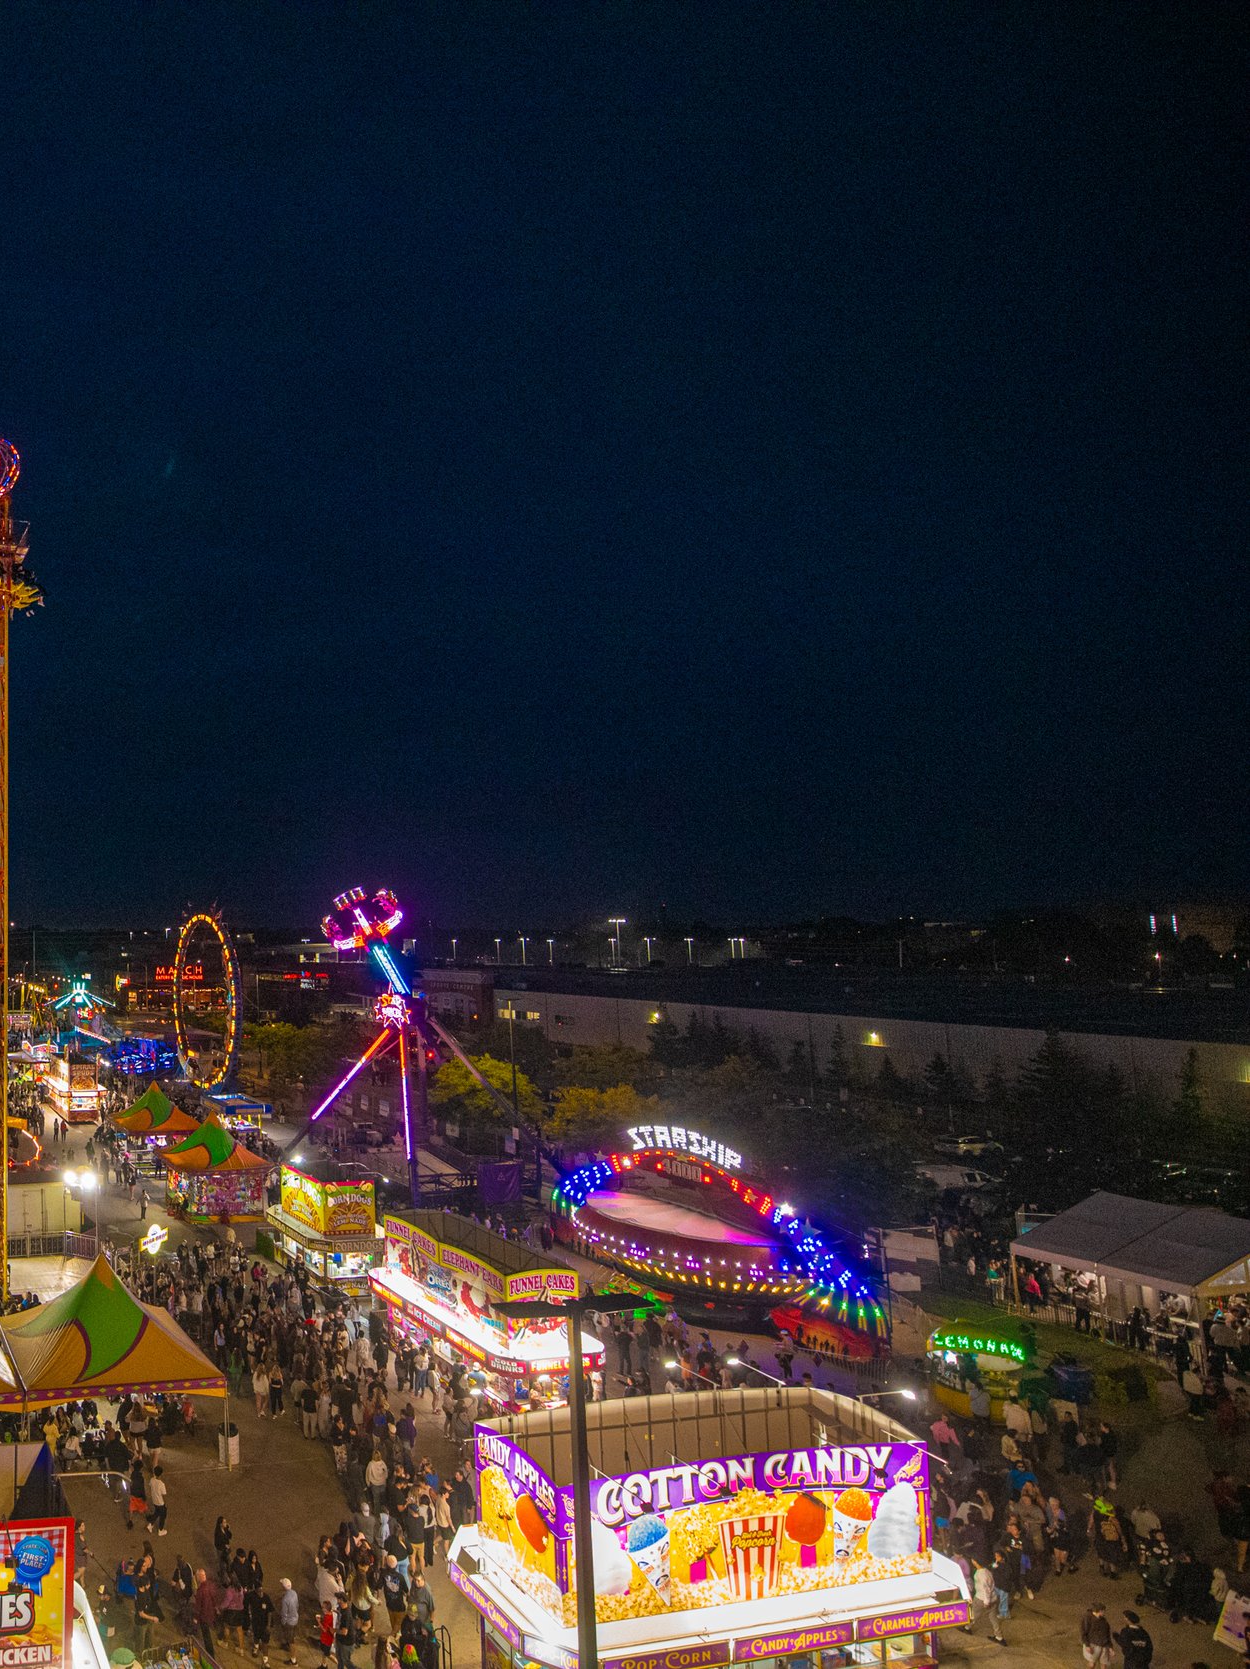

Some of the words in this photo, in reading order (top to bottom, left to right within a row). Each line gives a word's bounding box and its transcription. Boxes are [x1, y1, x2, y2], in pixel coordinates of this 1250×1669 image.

[156, 965, 203, 975] MACH
[627, 1125, 742, 1169] STARSHIP
[335, 1240, 384, 1251] CORNDOGS
[386, 1219, 411, 1241] FUNNEL
[411, 1232, 437, 1259] CAKES
[442, 1249, 480, 1278] ELEPHANT
[481, 1266, 505, 1294] EARS
[509, 1275, 544, 1296] FUNNEL
[546, 1273, 576, 1293] CAKES
[491, 1360, 524, 1374] DRINKS
[495, 1357, 517, 1367] COLD
[477, 1432, 511, 1472] CANDY
[514, 1450, 557, 1517] APPLES
[596, 1453, 756, 1528] COTTON
[764, 1444, 893, 1492] CANDY
[731, 1535, 777, 1551] Popcorn
[20, 1557, 44, 1570] PLACE
[22, 1551, 45, 1562] FIRST
[872, 1615, 916, 1635] CARAMEL
[917, 1609, 955, 1629] APPLES
[750, 1637, 790, 1657] CANDY
[792, 1626, 838, 1652] APPLES
